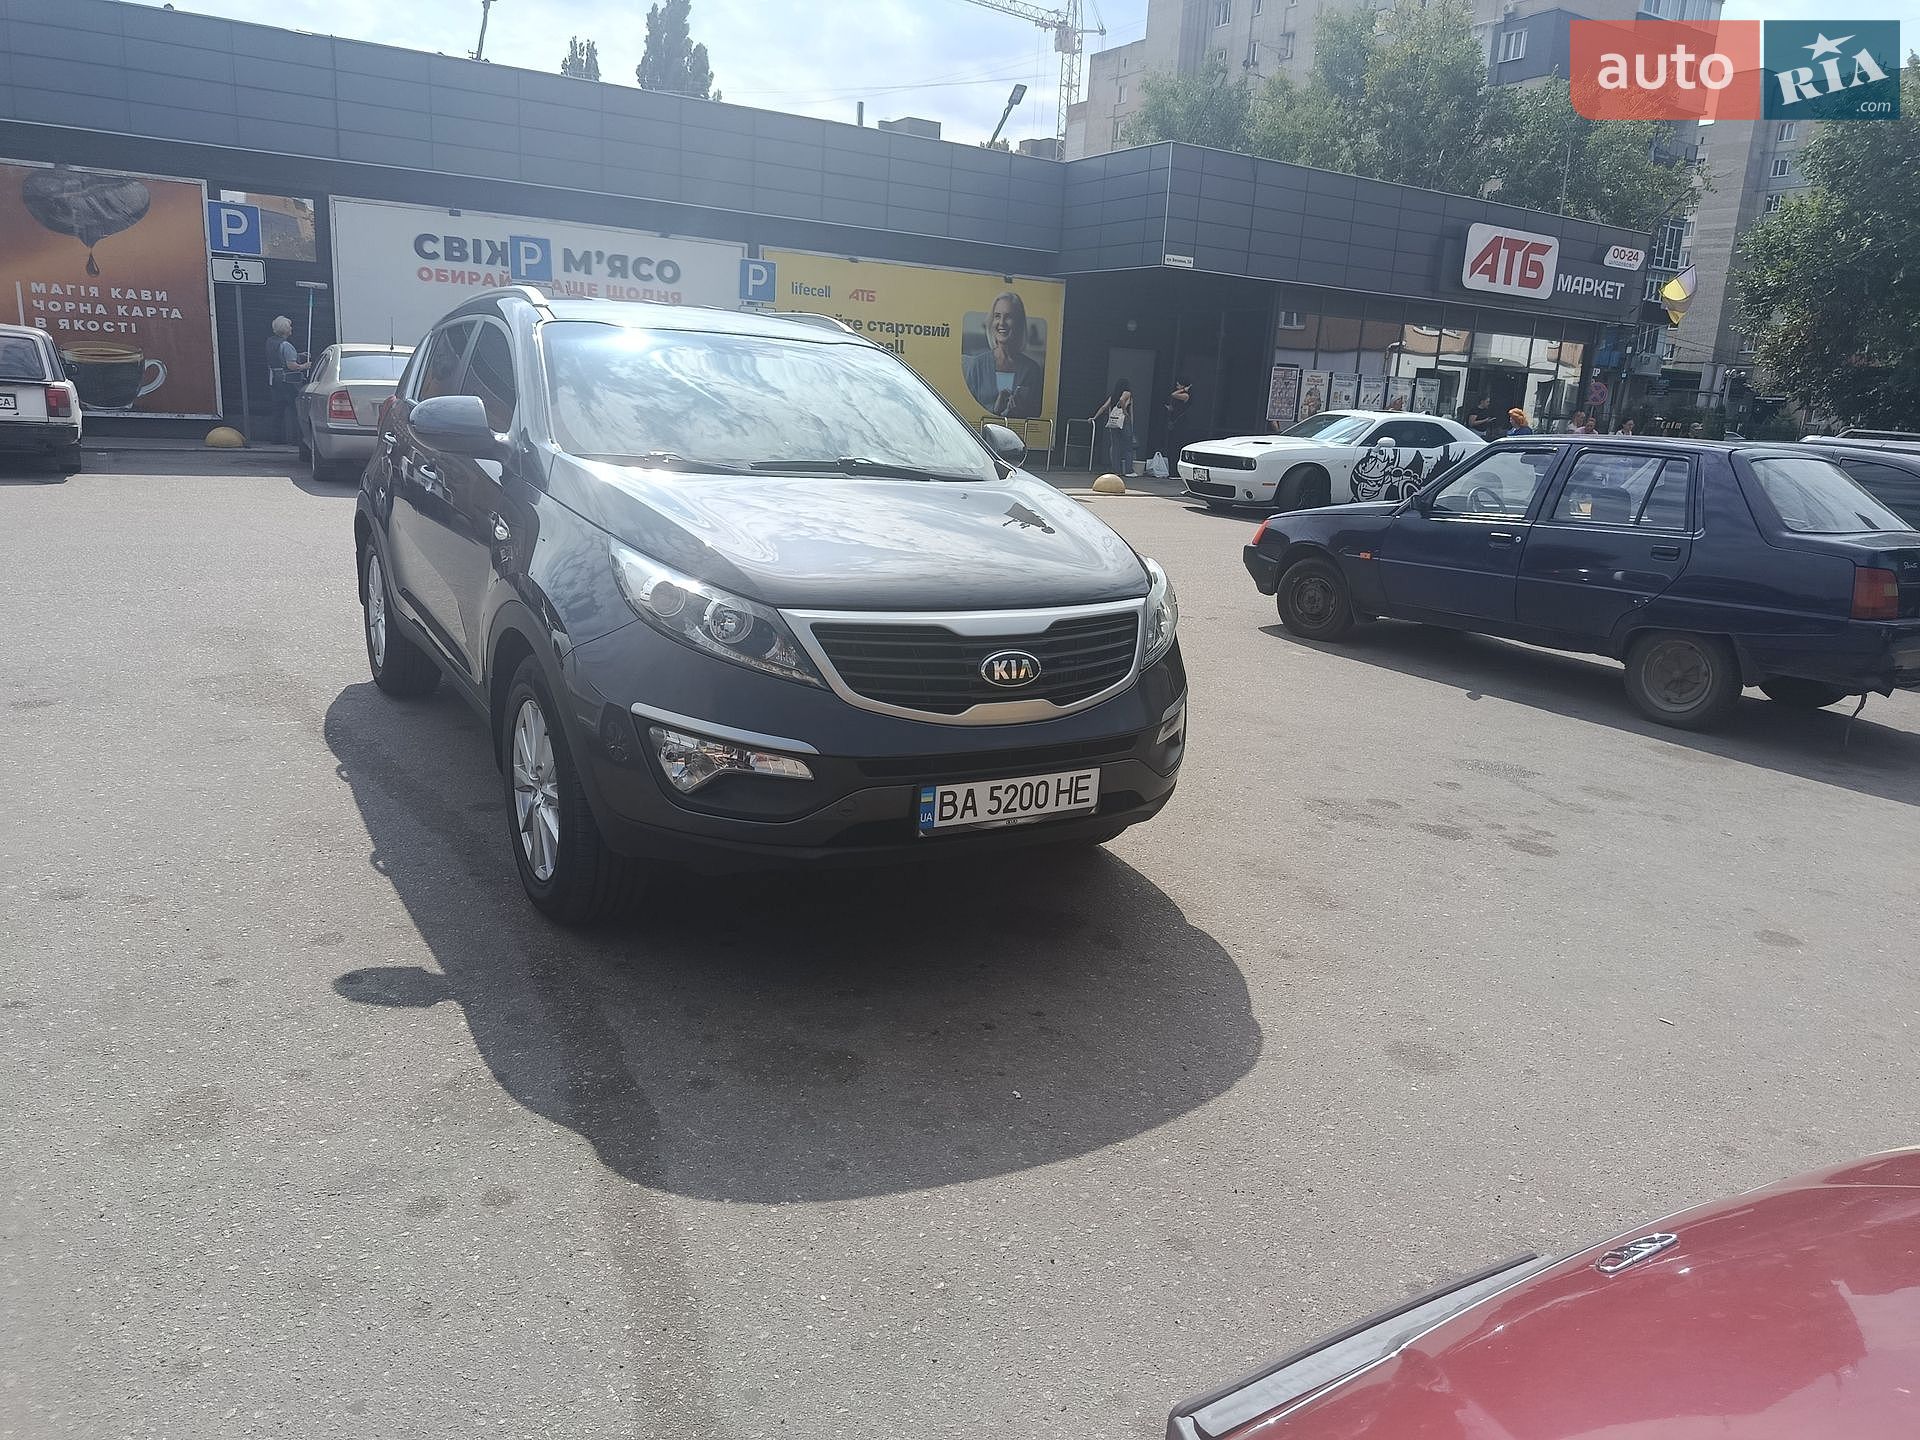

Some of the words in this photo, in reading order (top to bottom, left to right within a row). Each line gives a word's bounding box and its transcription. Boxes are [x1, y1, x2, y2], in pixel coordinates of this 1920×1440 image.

[413, 233, 510, 268] СВІЖ
[1612, 248, 1640, 262] 00-24
[1469, 235, 1553, 290] АТБ
[30, 282, 99, 298] МАГІЯ
[111, 287, 168, 302] КАВИ
[416, 267, 513, 288] ОБИРАЙ
[606, 284, 682, 304] ЩОДНЯ
[791, 282, 831, 299] lifecell
[849, 288, 877, 303] АТБ
[1557, 273, 1625, 301] МАРКЕТ
[32, 299, 107, 316] ЧОРНА
[117, 304, 183, 319] КАРТА
[35, 317, 48, 329] В
[58, 319, 137, 333] ЯКОСТІ
[867, 320, 950, 338] стартовий
[992, 659, 1034, 681] KIA
[938, 788, 978, 822] BA
[986, 780, 1049, 816] 5200
[1055, 774, 1091, 807] HE
[920, 813, 933, 823] UA
